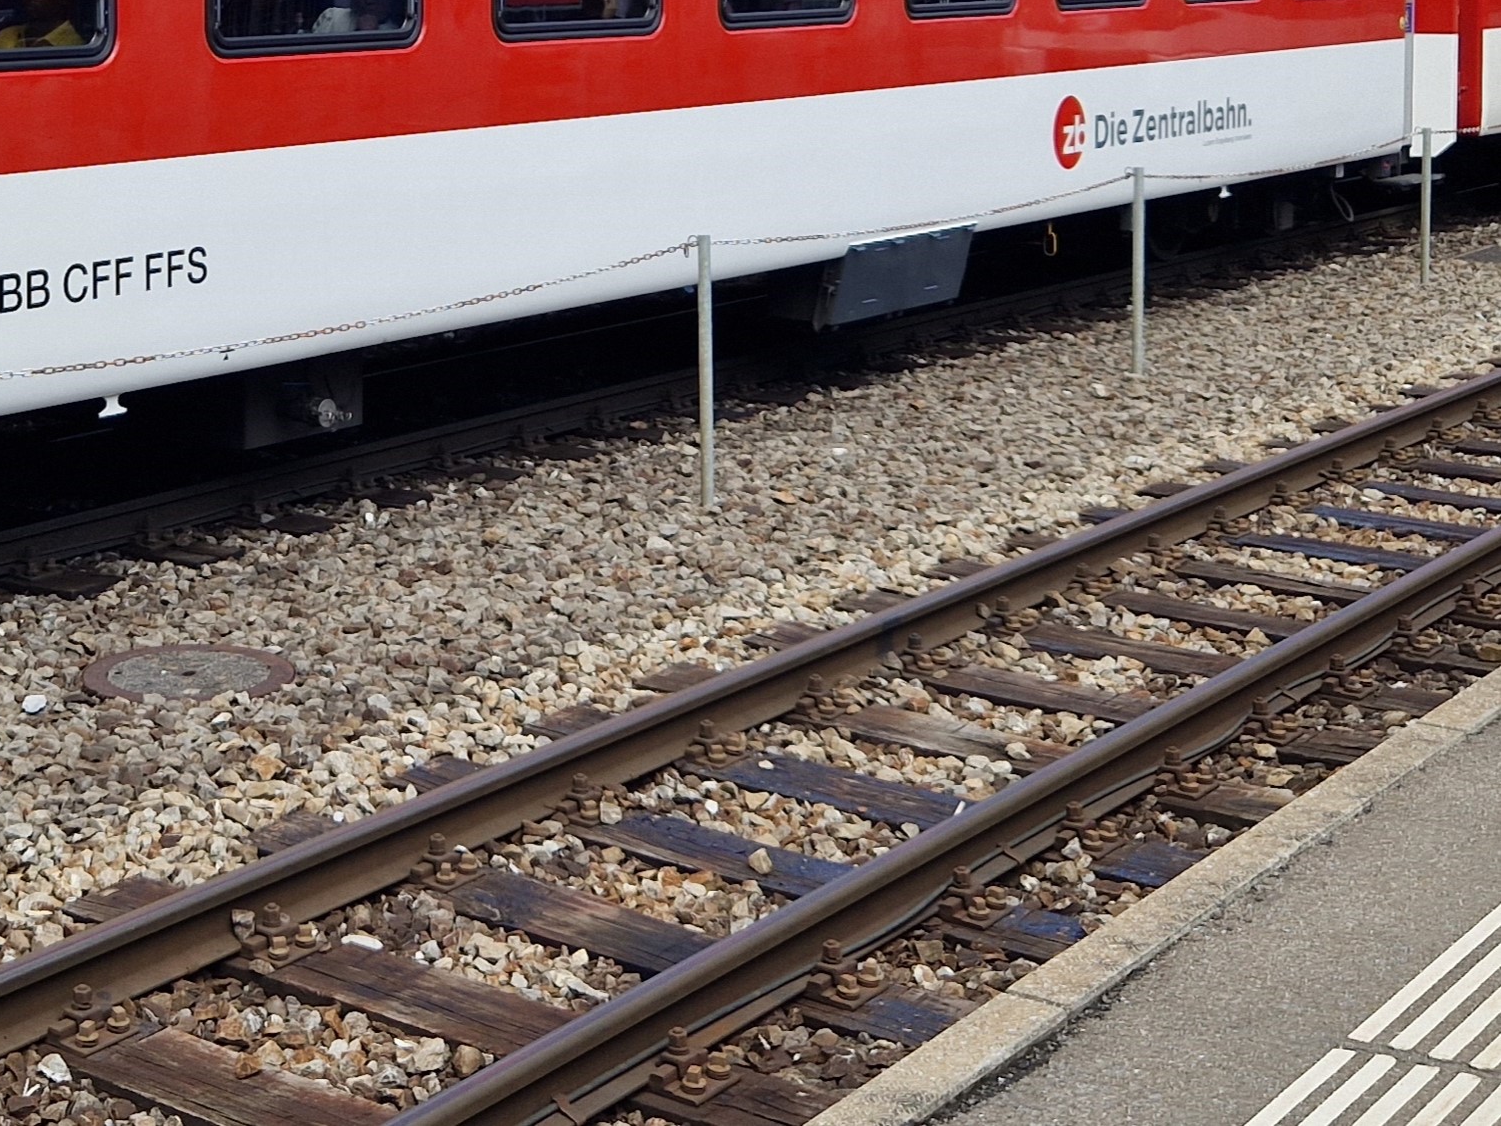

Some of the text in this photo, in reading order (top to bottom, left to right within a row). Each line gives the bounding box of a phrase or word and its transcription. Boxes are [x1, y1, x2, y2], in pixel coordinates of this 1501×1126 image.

[1062, 114, 1085, 155] zb
[1095, 96, 1253, 149] Die Zentralbahn.
[63, 256, 134, 303] CFF
[145, 246, 208, 291] FFS
